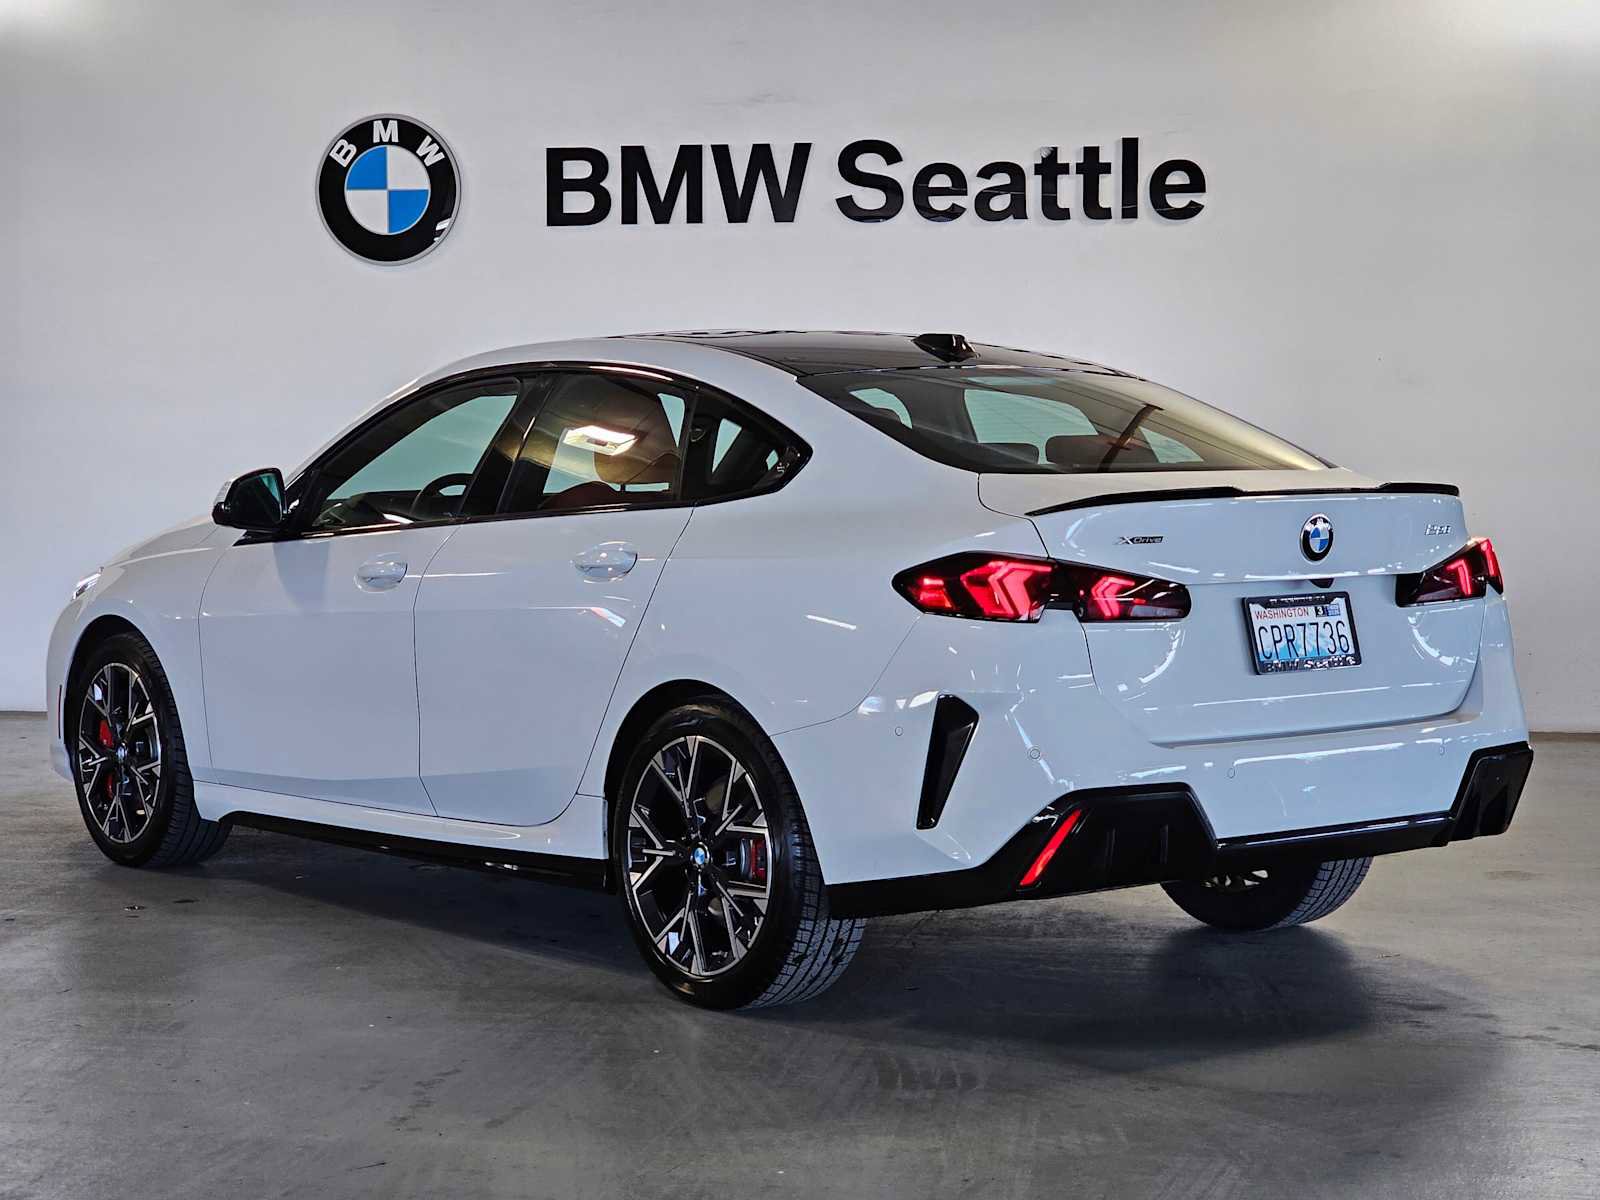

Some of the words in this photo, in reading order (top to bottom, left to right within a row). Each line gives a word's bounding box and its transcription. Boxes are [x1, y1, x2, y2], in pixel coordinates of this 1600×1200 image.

[329, 120, 445, 168] BMW
[545, 142, 812, 226] BMW
[835, 137, 1207, 222] Seattle
[1255, 607, 1309, 620] WASHINGTON
[1317, 606, 1324, 615] 3
[1258, 620, 1350, 659] CPR7736
